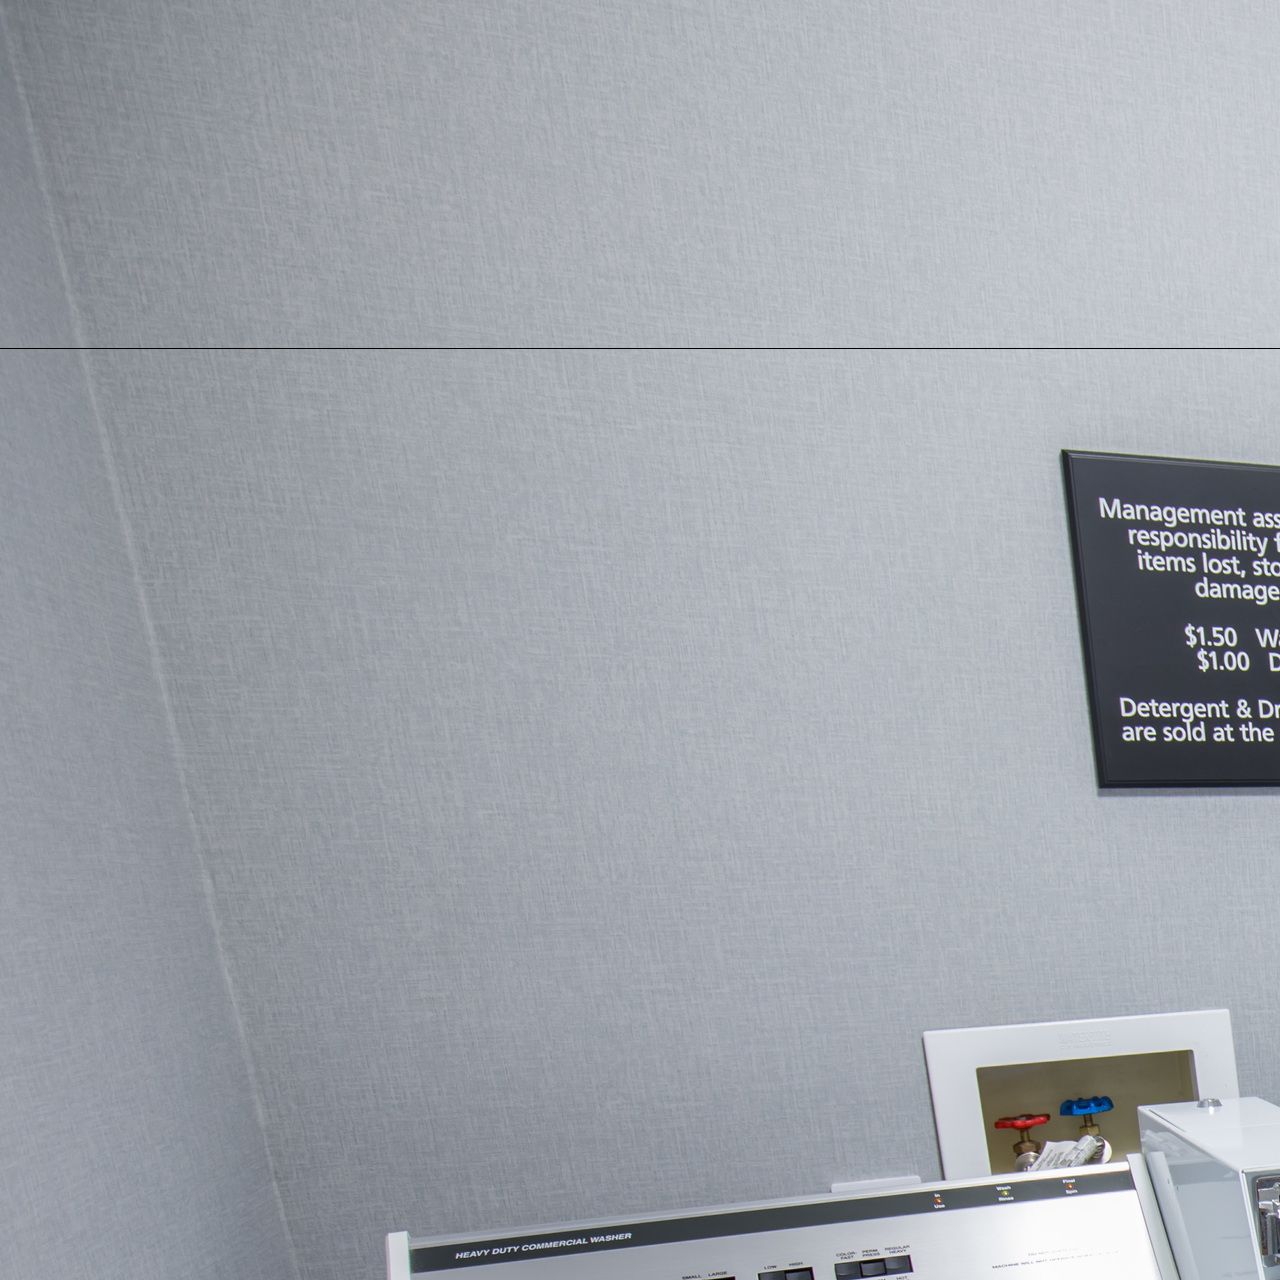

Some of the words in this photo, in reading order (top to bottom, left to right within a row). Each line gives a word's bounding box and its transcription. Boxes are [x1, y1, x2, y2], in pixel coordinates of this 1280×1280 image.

[1098, 496, 1247, 528] Management
[1127, 526, 1269, 557] responsibility
[1136, 549, 1197, 573] items
[1201, 552, 1246, 579] lost,
[1184, 623, 1238, 649] $1.50
[1196, 648, 1250, 673] $1.00
[1119, 696, 1230, 724] Detergent
[1236, 699, 1253, 719] &
[1121, 725, 1157, 742] are
[1162, 721, 1206, 743] sold
[1212, 723, 1235, 743] at
[1239, 722, 1275, 743] the
[455, 1248, 491, 1261] HEAVY
[491, 1245, 520, 1255] DUTY
[521, 1237, 588, 1252] COMMERCIAL
[590, 1232, 632, 1244] WASHER
